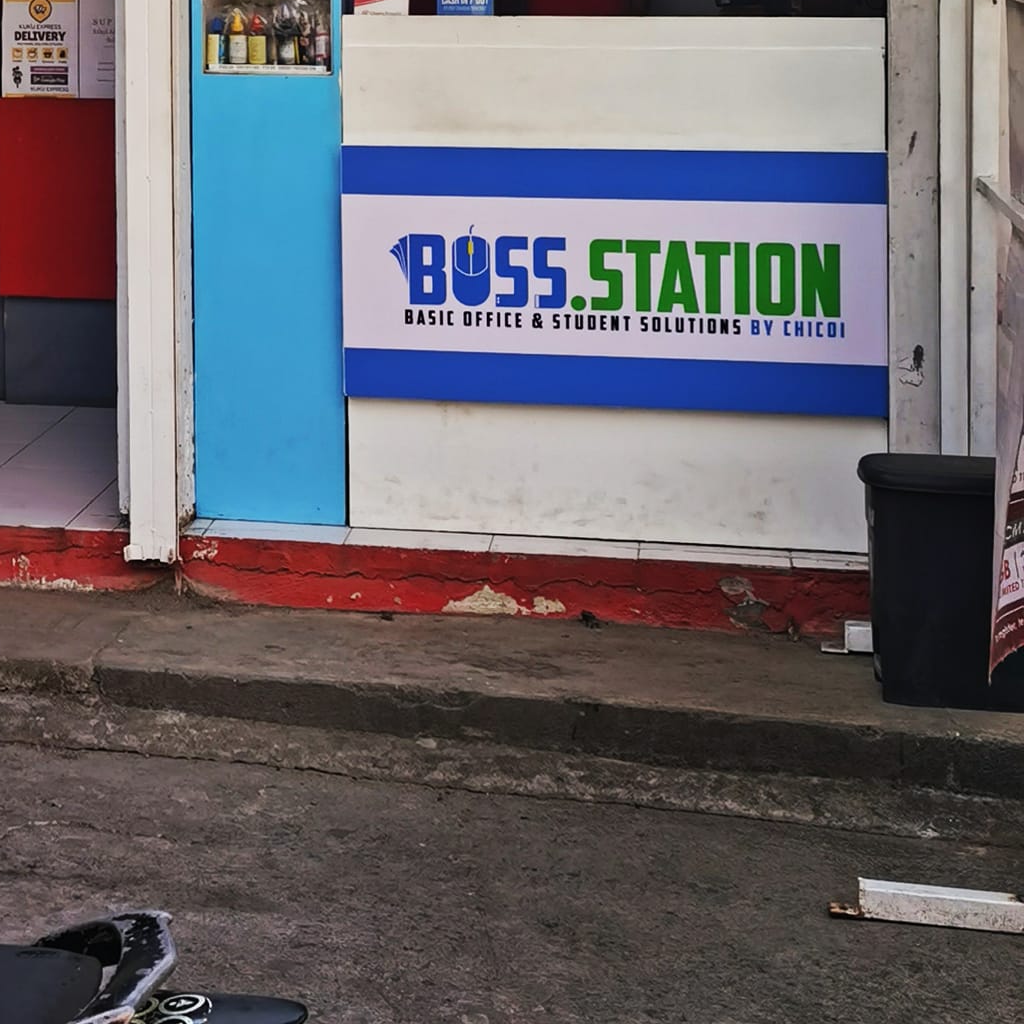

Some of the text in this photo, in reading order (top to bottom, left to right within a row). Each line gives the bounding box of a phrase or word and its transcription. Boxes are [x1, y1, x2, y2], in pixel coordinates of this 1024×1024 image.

[14, 31, 66, 41] DELIVERY
[404, 308, 845, 338] BASIC OFFICE & STUDENT SOLUTIONS BY CHICOI
